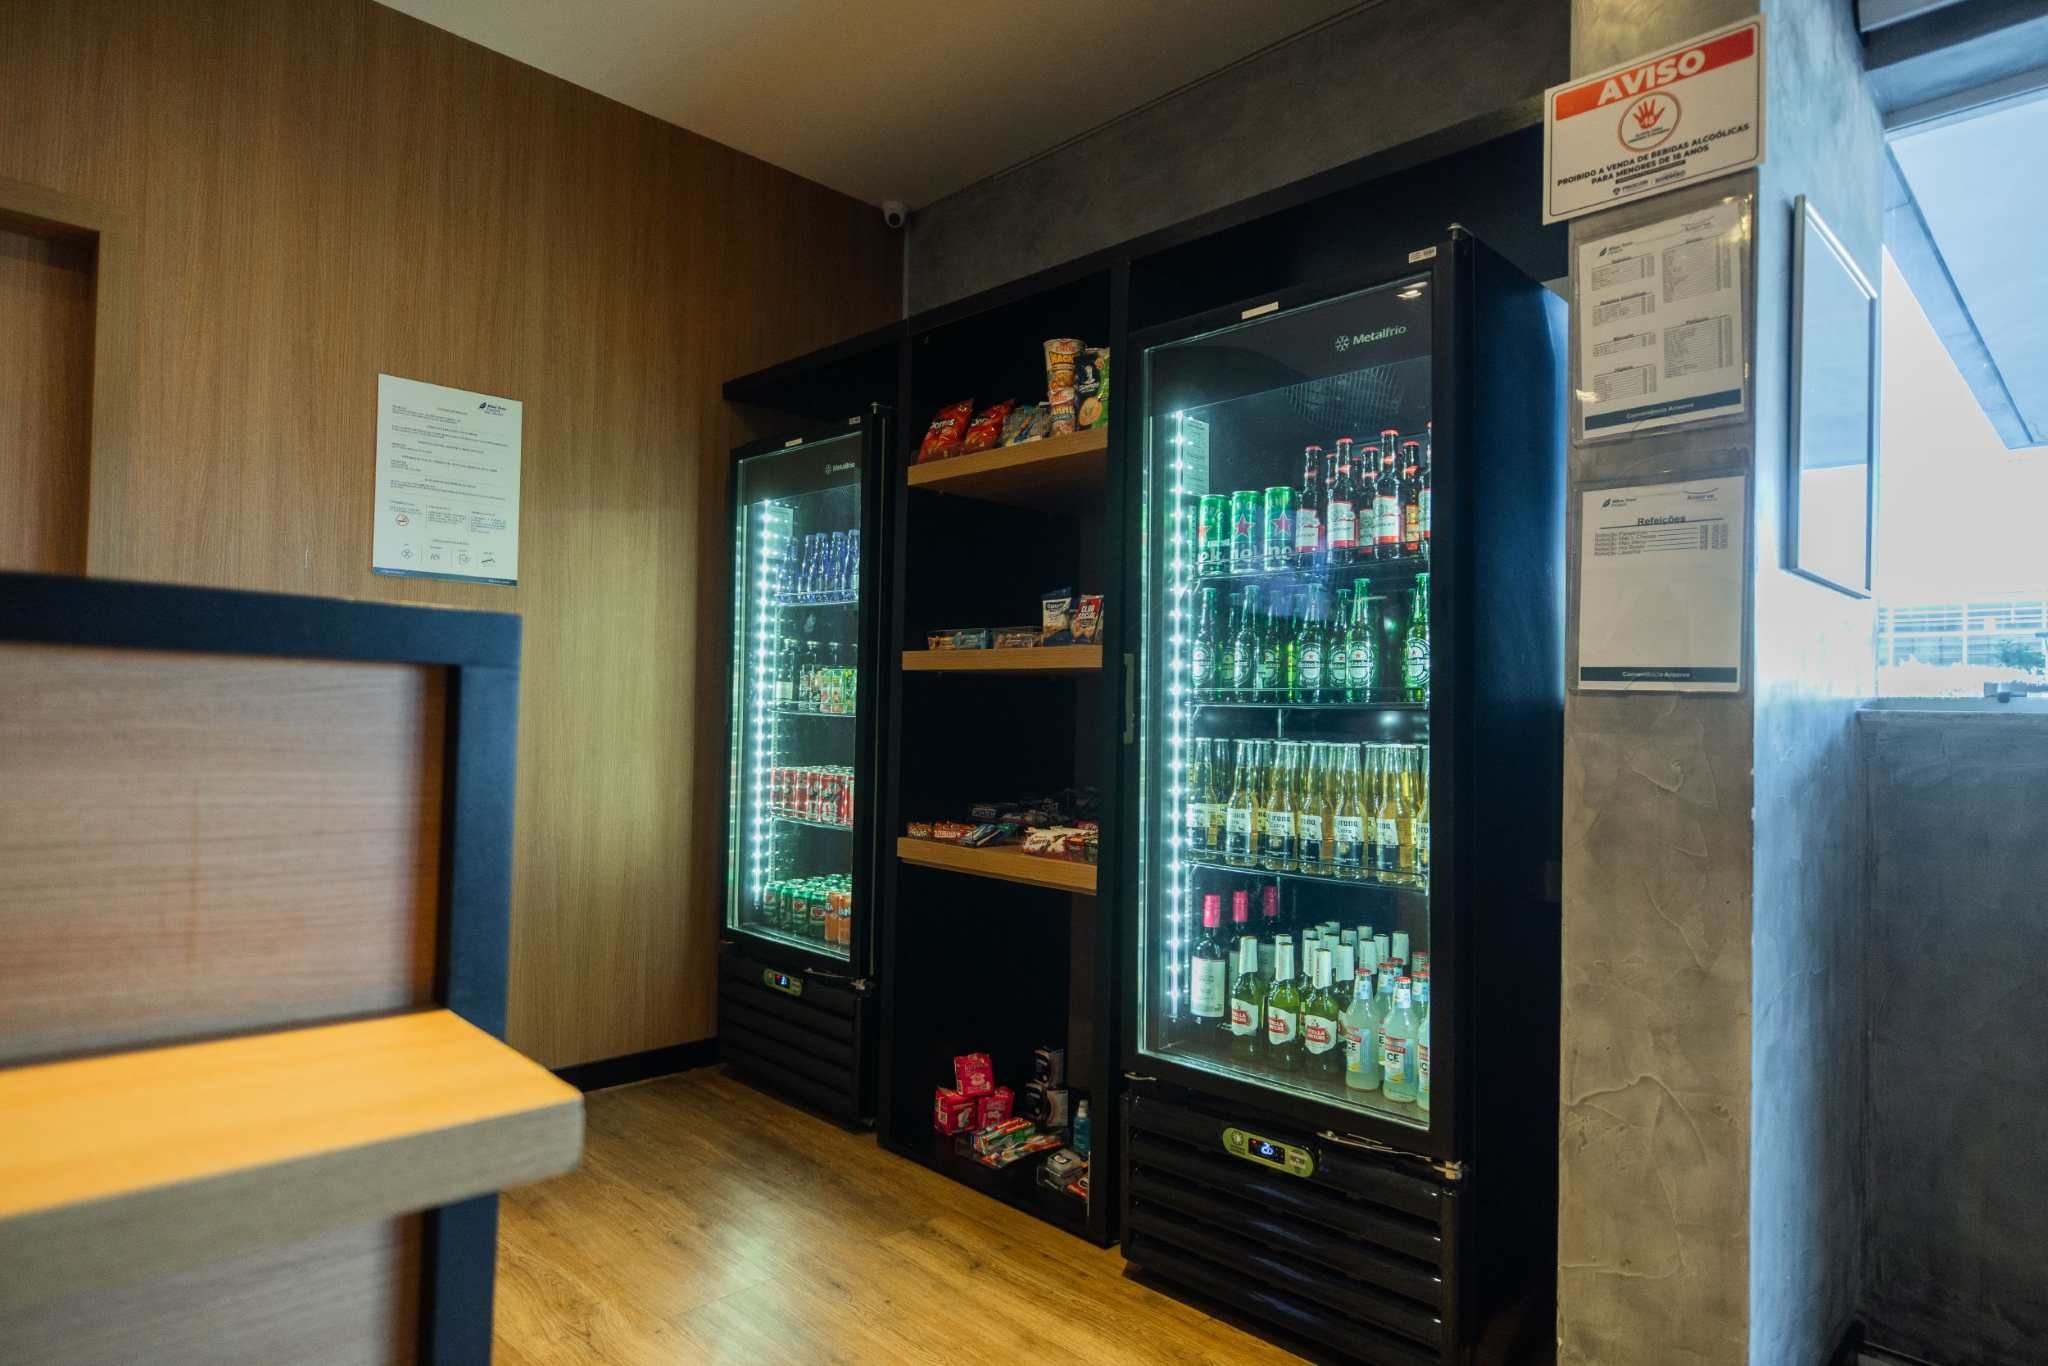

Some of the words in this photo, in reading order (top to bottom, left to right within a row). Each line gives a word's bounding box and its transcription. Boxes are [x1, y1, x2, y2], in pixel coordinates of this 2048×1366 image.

[1598, 49, 1705, 106] AVISO
[1557, 169, 1597, 187] PROIBIDO
[1599, 167, 1605, 176] A
[1606, 159, 1635, 172] VENDA
[1637, 154, 1649, 163] DE
[1651, 142, 1689, 159] BEBIDAS
[1691, 123, 1750, 146] ALCOÓLICAS
[1591, 174, 1614, 185] PARA
[1615, 161, 1656, 180] MENORES
[1659, 157, 1670, 166] DE
[1672, 153, 1682, 162] 18
[1684, 145, 1710, 159] ANOS
[1353, 326, 1407, 345] Metalfrio
[1637, 515, 1686, 526] Refeições
